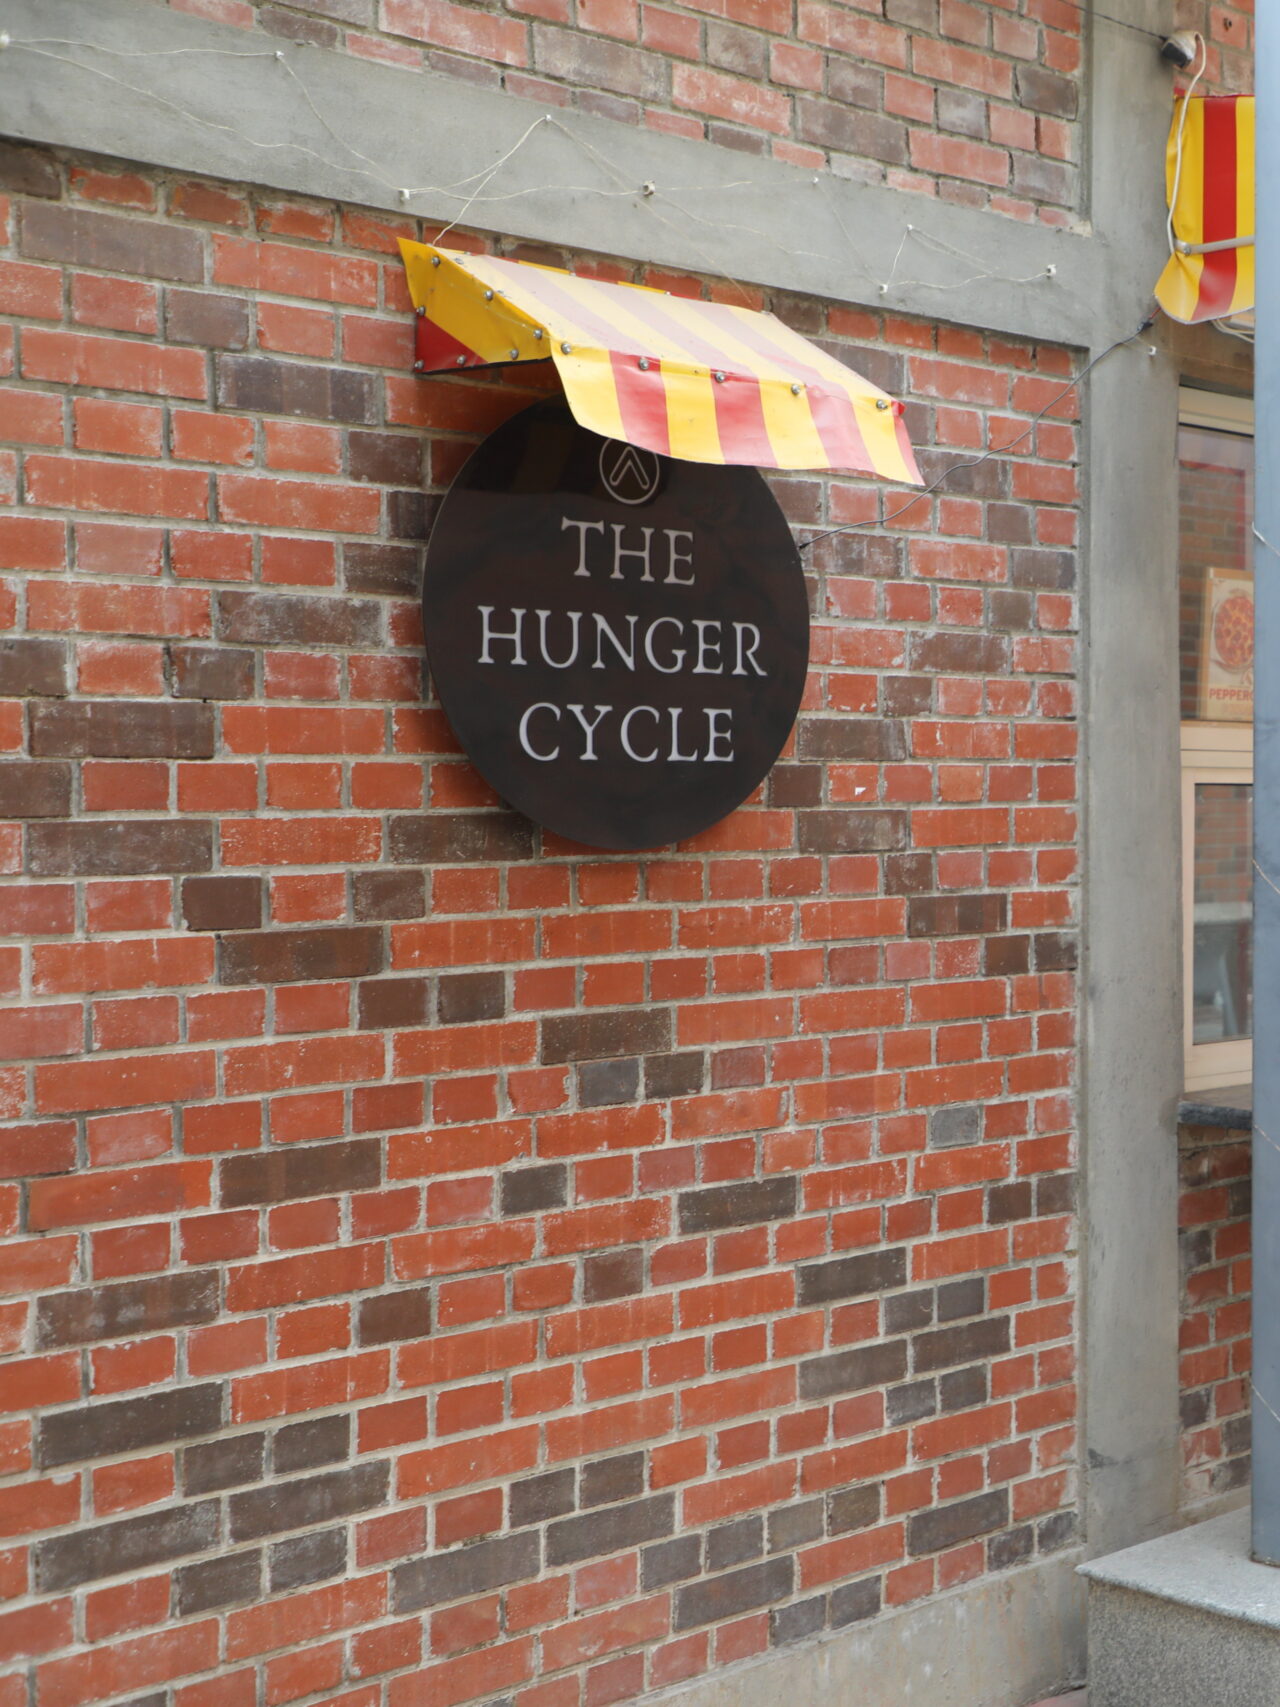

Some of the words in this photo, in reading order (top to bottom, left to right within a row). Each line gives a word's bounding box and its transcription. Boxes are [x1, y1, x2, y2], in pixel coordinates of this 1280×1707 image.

[561, 516, 696, 586] THE
[477, 605, 768, 677] HUNGER
[519, 702, 735, 763] CYCLE
